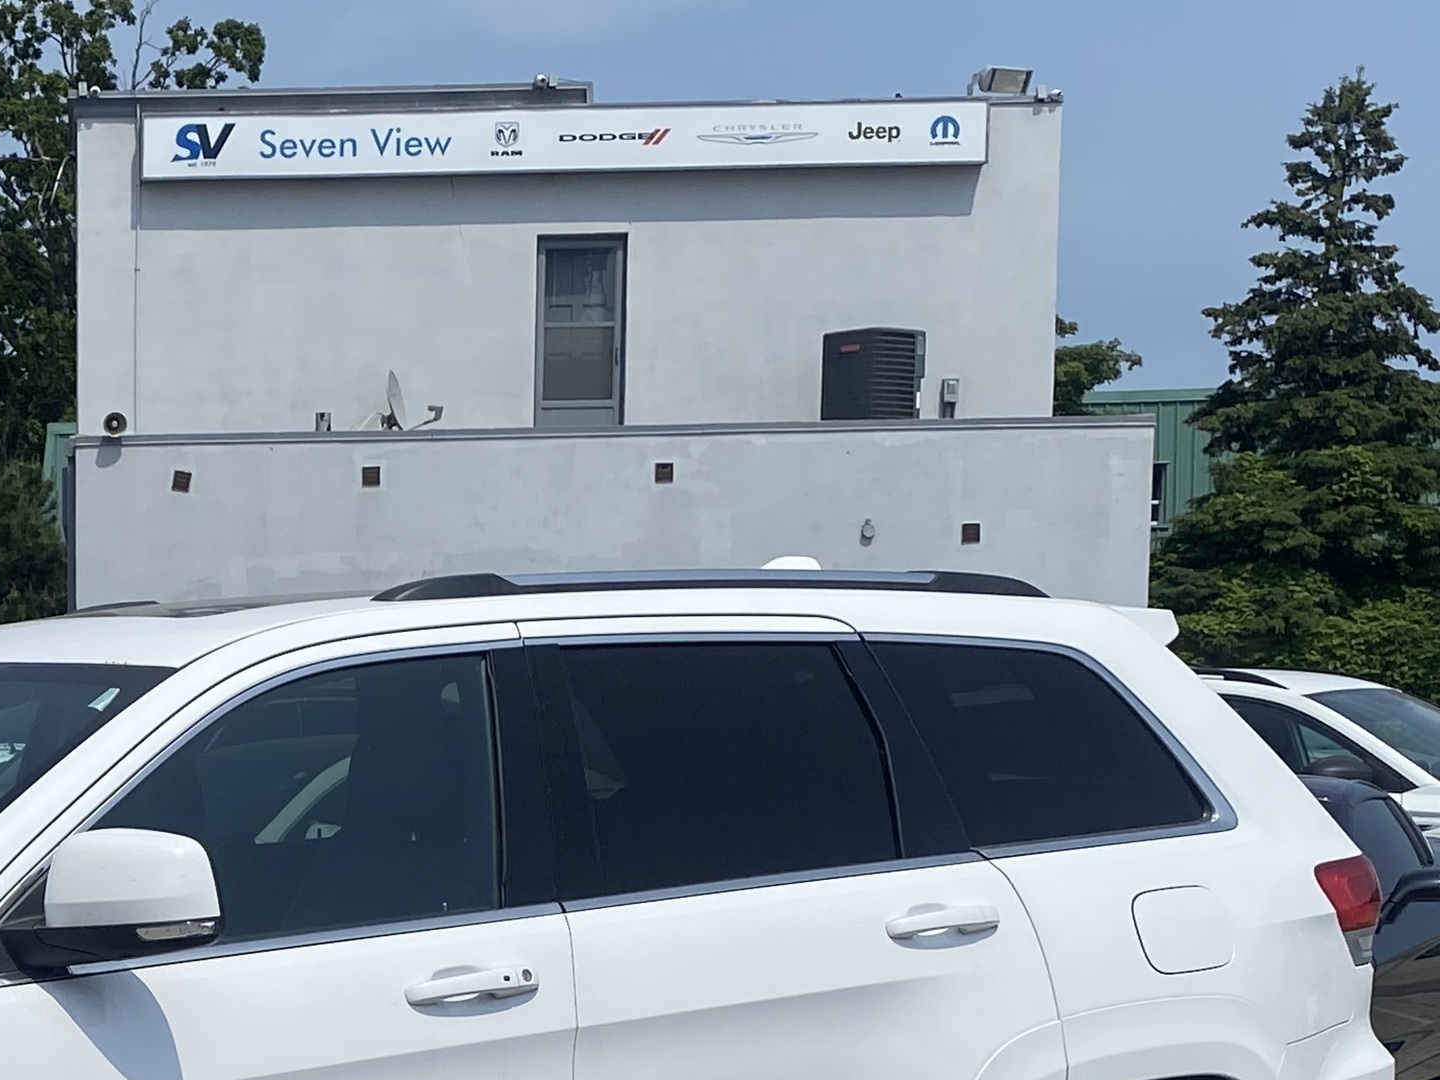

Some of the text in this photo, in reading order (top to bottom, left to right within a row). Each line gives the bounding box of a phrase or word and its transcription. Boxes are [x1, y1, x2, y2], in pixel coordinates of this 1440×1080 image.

[559, 132, 651, 142] DODGE
[712, 123, 803, 132] CHRYSLER
[848, 122, 901, 142] Jeep
[171, 123, 236, 162] SV
[259, 126, 451, 159] Seven View
